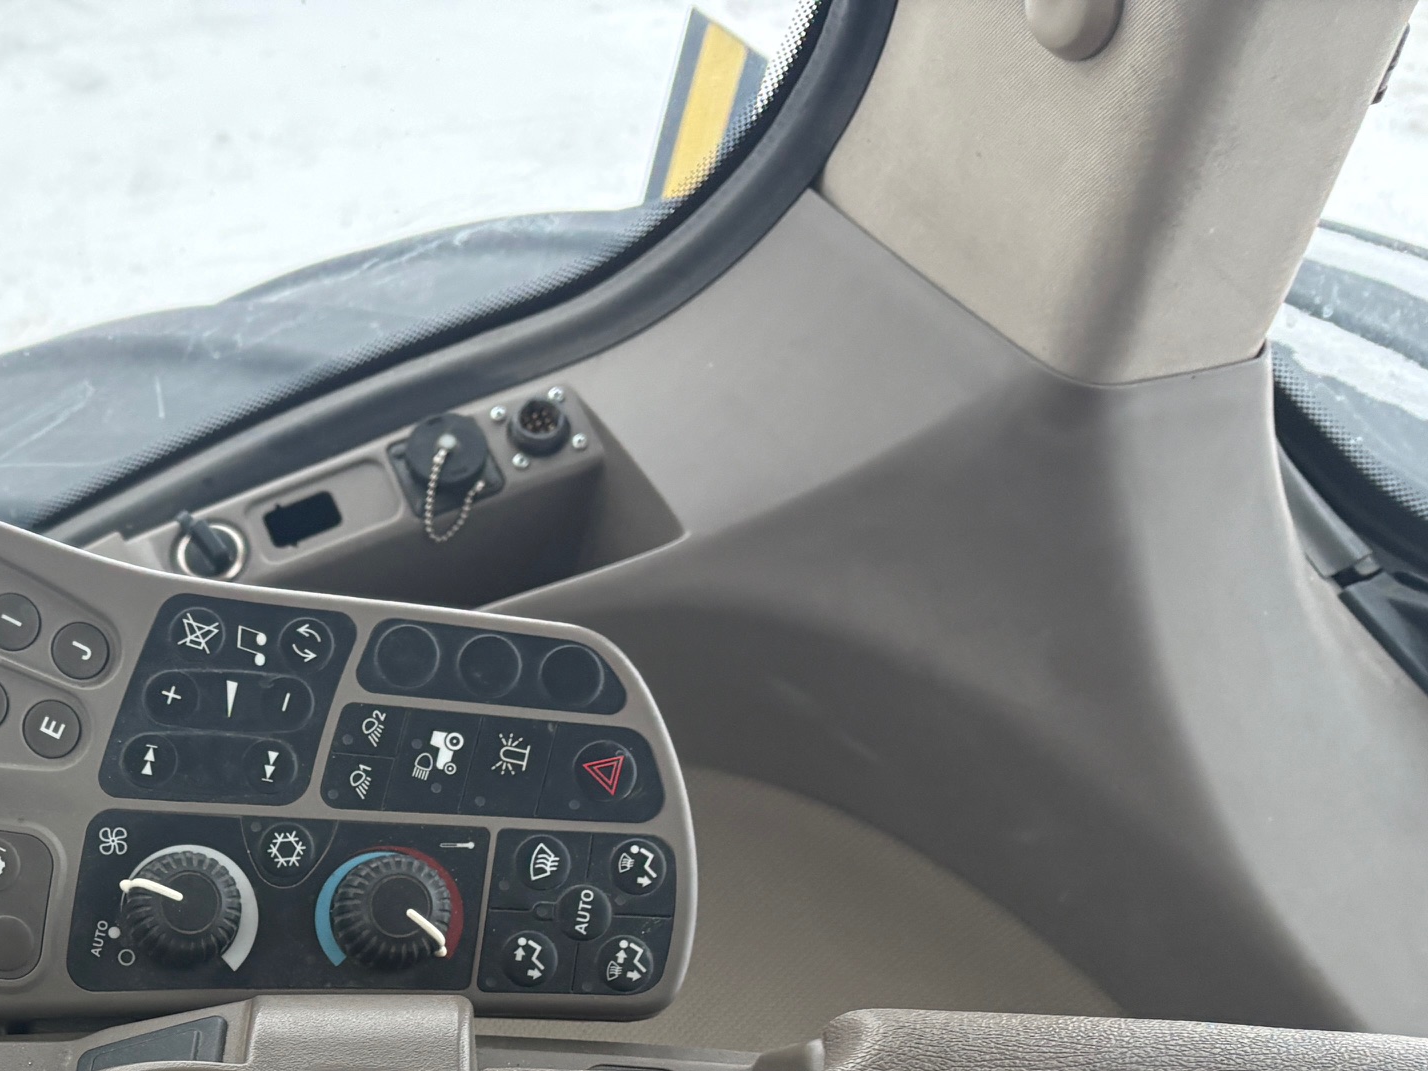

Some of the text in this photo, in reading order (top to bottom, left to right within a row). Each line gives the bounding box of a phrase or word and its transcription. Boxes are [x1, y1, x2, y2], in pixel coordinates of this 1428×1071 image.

[1, 614, 22, 627] I
[72, 640, 92, 661] J
[39, 716, 66, 740] E
[574, 889, 594, 935] AUTO
[90, 920, 109, 958] AUTO
